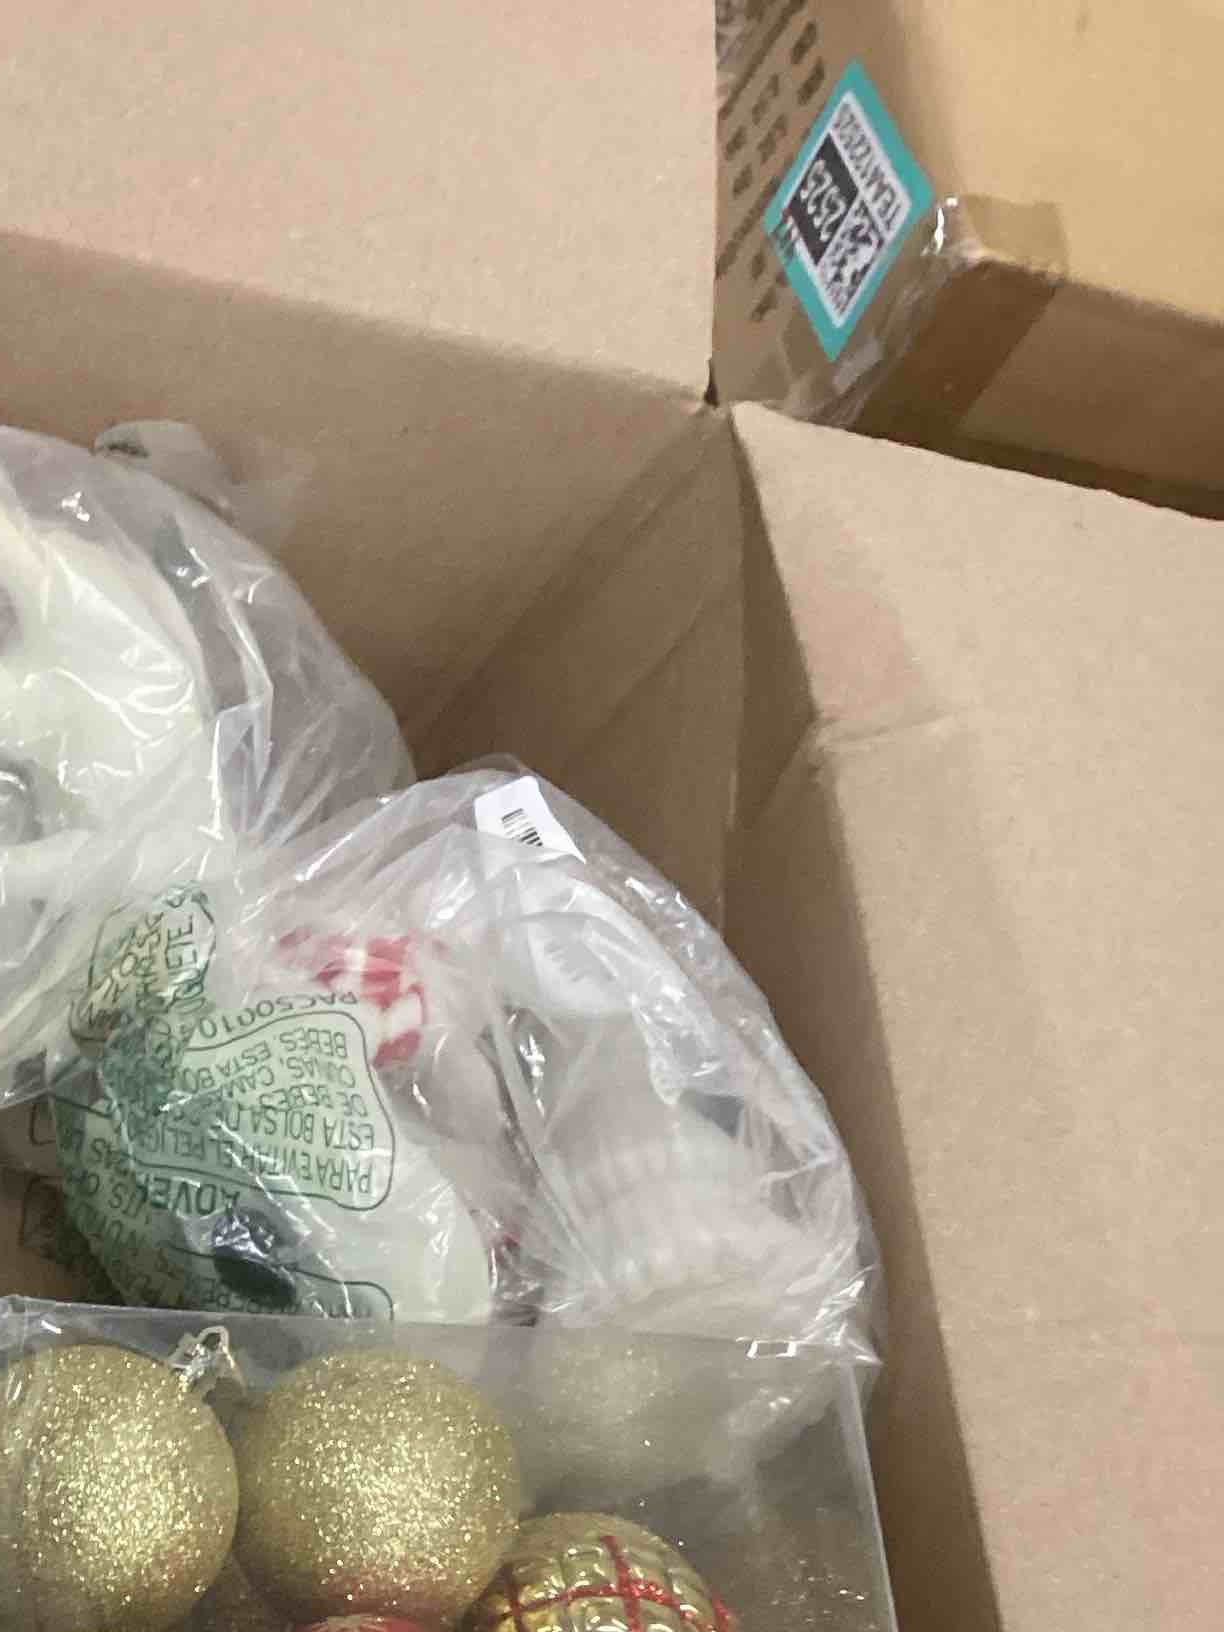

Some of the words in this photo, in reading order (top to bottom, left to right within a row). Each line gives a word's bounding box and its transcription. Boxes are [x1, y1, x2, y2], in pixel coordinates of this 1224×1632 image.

[248, 1103, 314, 1142] BOLSA
[321, 1117, 374, 1149] ESTA
[315, 1156, 371, 1193] PARA
